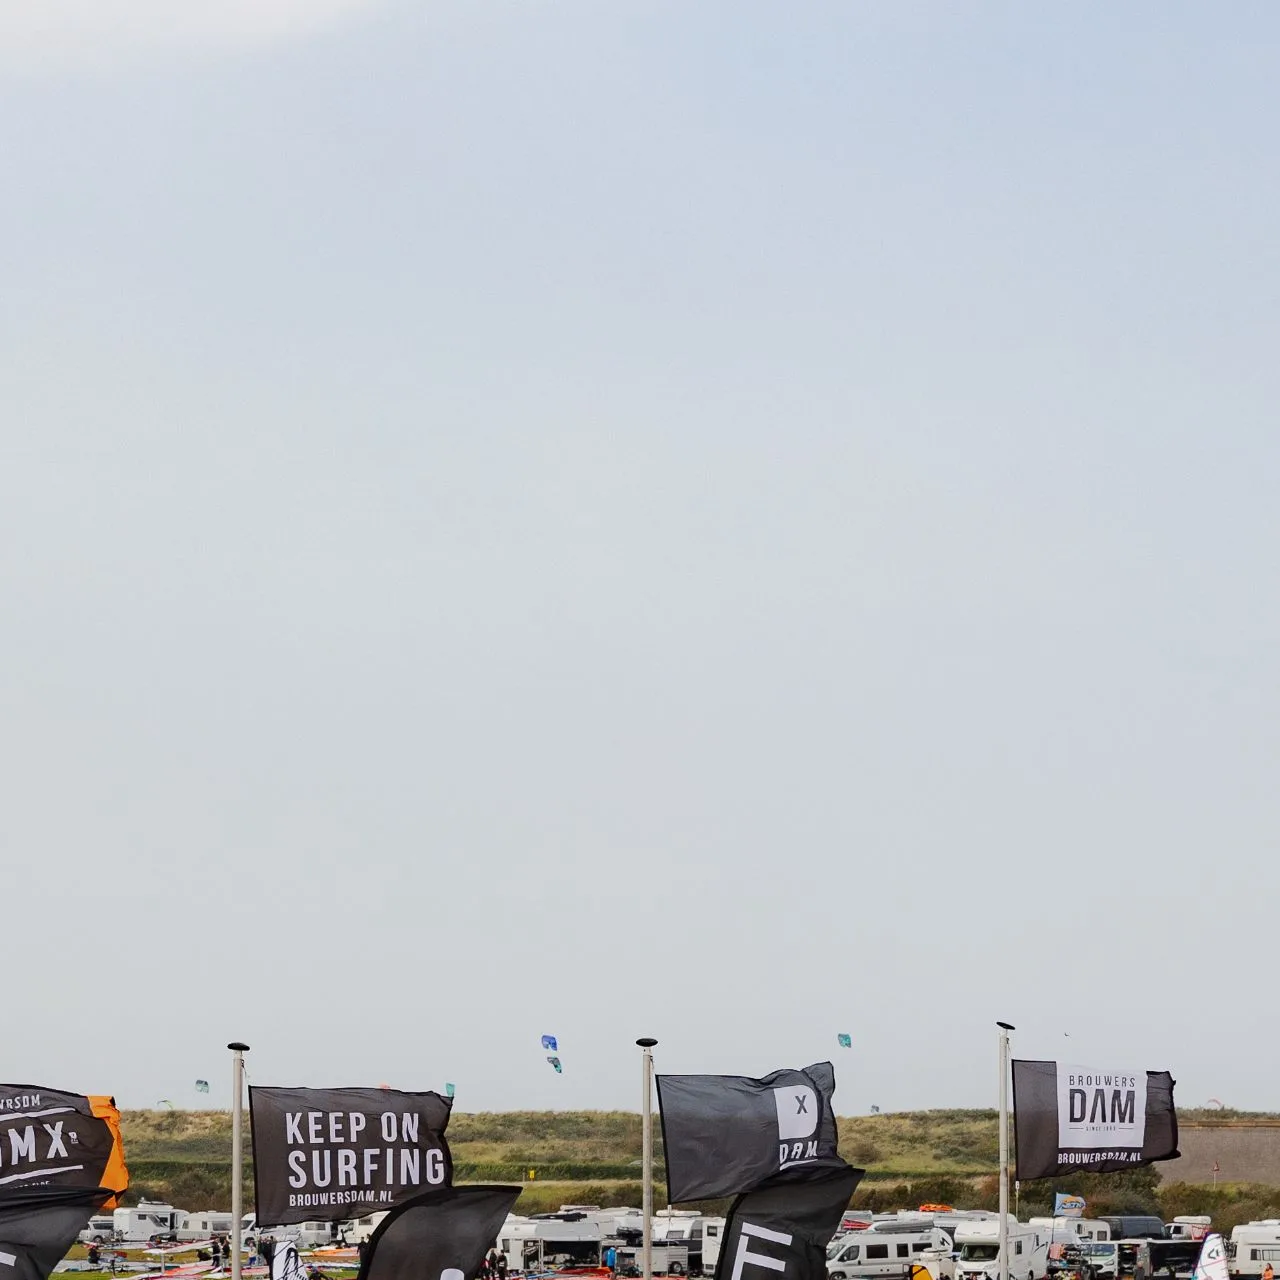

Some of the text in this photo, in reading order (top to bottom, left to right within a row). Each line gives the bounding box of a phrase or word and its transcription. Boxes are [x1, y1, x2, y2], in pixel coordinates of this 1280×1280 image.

[1069, 1075, 1136, 1088] BROUWERS
[1069, 1088, 1136, 1124] DAM
[285, 1111, 419, 1145] KEEP ON
[778, 1139, 819, 1164] DAM
[1057, 1152, 1142, 1164] BROUWERSDAM.NL
[287, 1147, 445, 1189] SURFING
[288, 1189, 394, 1207] BROUWERSDAM.NL
